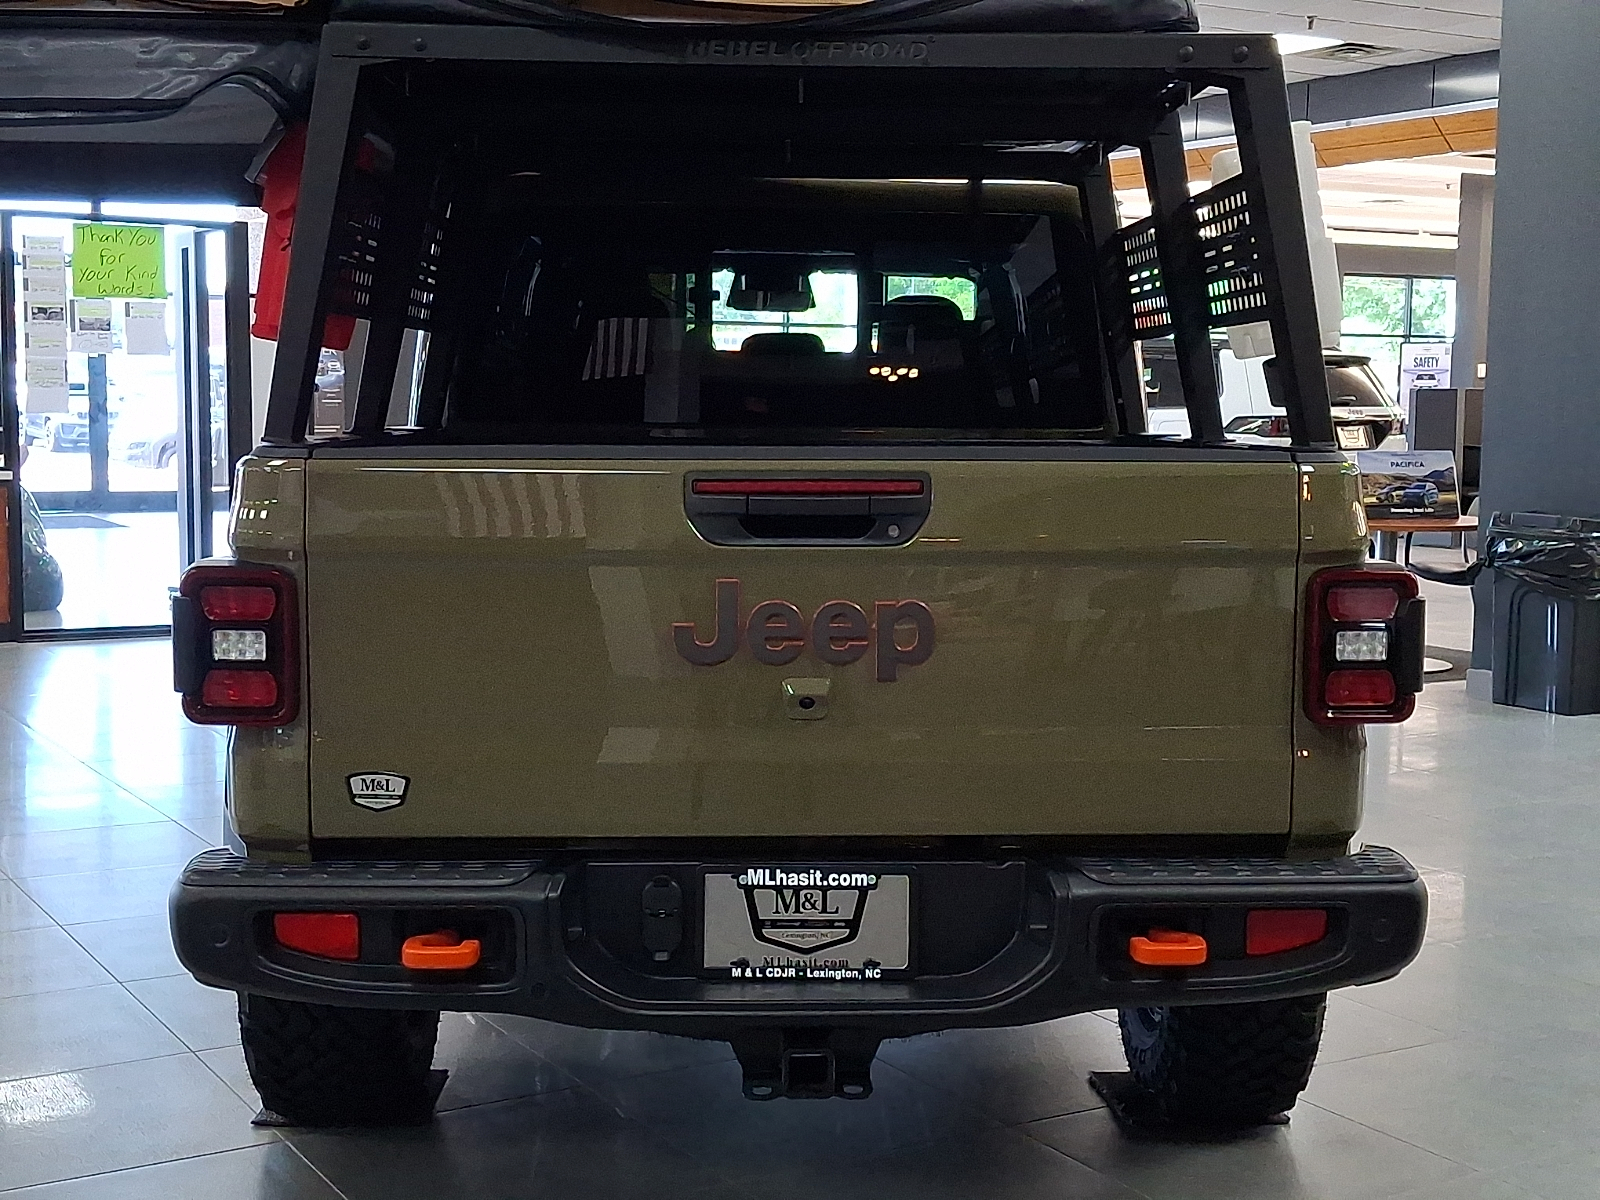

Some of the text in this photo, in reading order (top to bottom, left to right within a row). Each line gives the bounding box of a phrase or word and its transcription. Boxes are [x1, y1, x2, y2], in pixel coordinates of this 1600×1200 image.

[848, 41, 928, 60] ROAD
[77, 225, 157, 247] Thank You
[126, 264, 159, 282] Kind
[1413, 356, 1440, 368] SAFETY
[671, 578, 937, 682] Jeep
[360, 777, 396, 793] M&L
[747, 868, 869, 887] MLhasit.com
[772, 888, 840, 915] M&L
[762, 956, 850, 968] MLhasit.com
[731, 967, 742, 978] M
[744, 967, 753, 978] &
[755, 967, 764, 978] L
[765, 967, 797, 978] CDJR
[806, 968, 862, 980] Lexington,
[865, 969, 882, 979] NC
